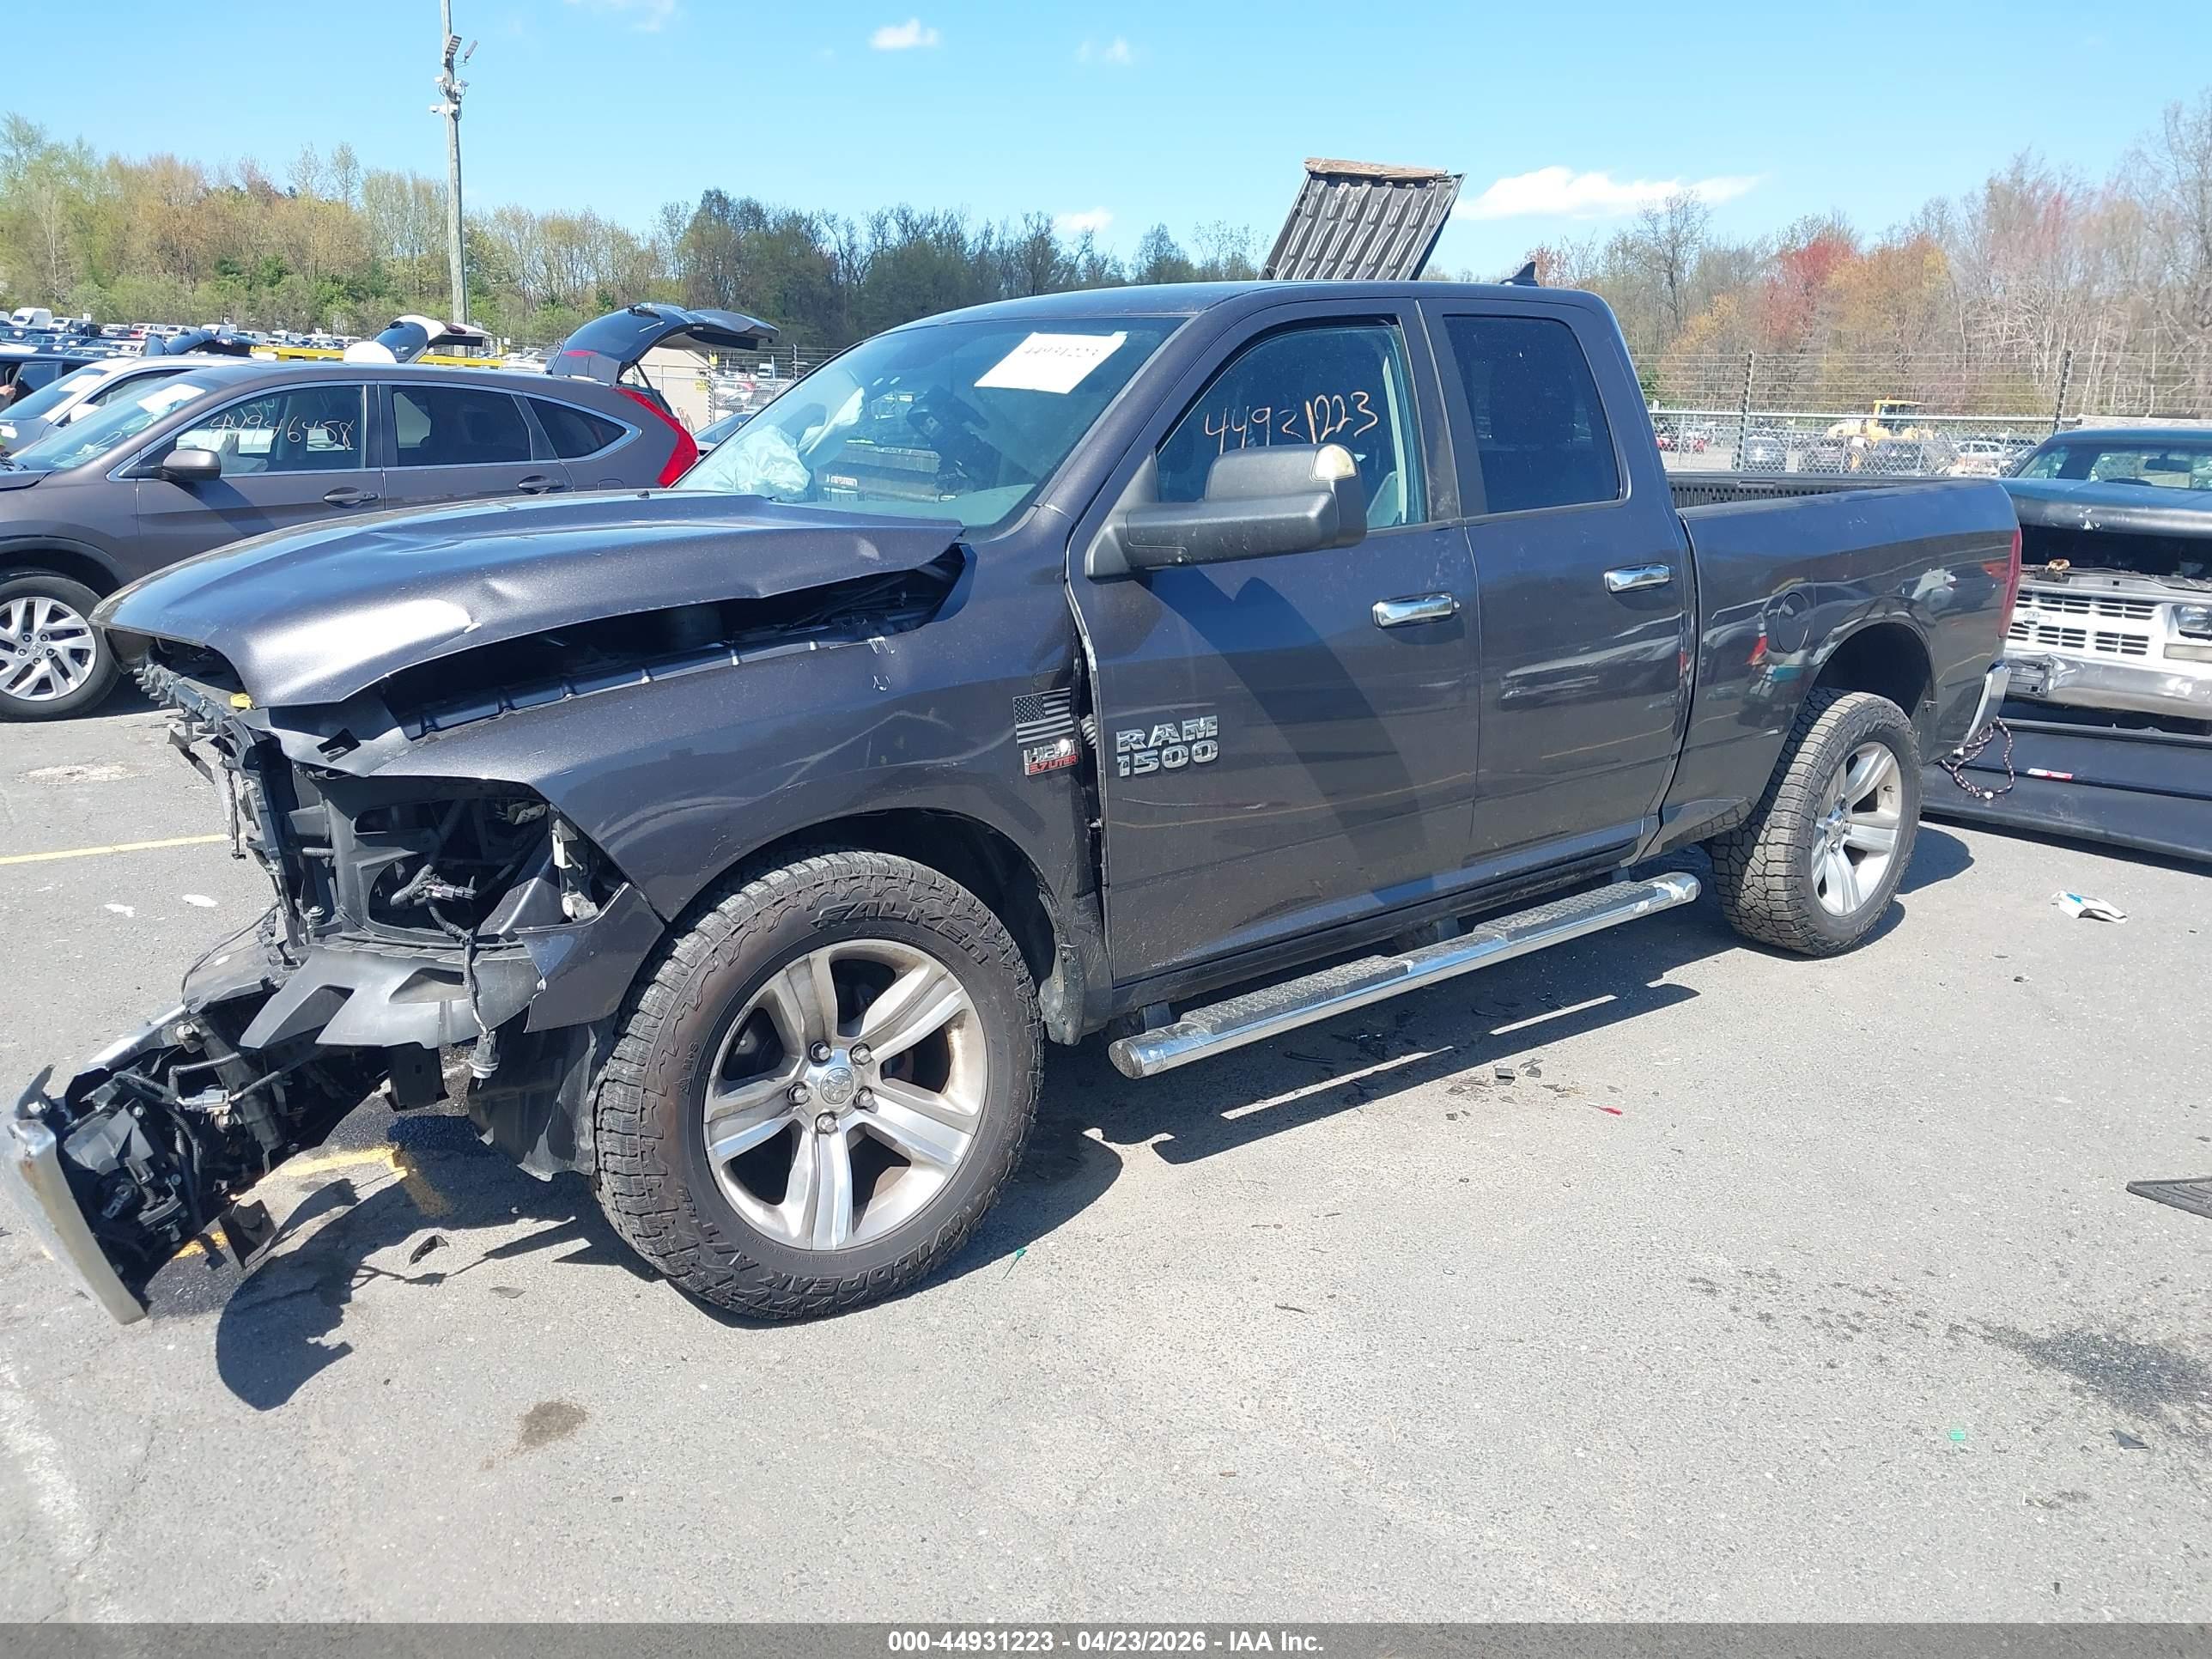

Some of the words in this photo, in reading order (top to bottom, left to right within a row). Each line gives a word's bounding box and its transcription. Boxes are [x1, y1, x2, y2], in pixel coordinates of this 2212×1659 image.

[1115, 715, 1218, 753] RAM
[1048, 755, 1078, 769] LITER
[1116, 739, 1218, 777] 1500
